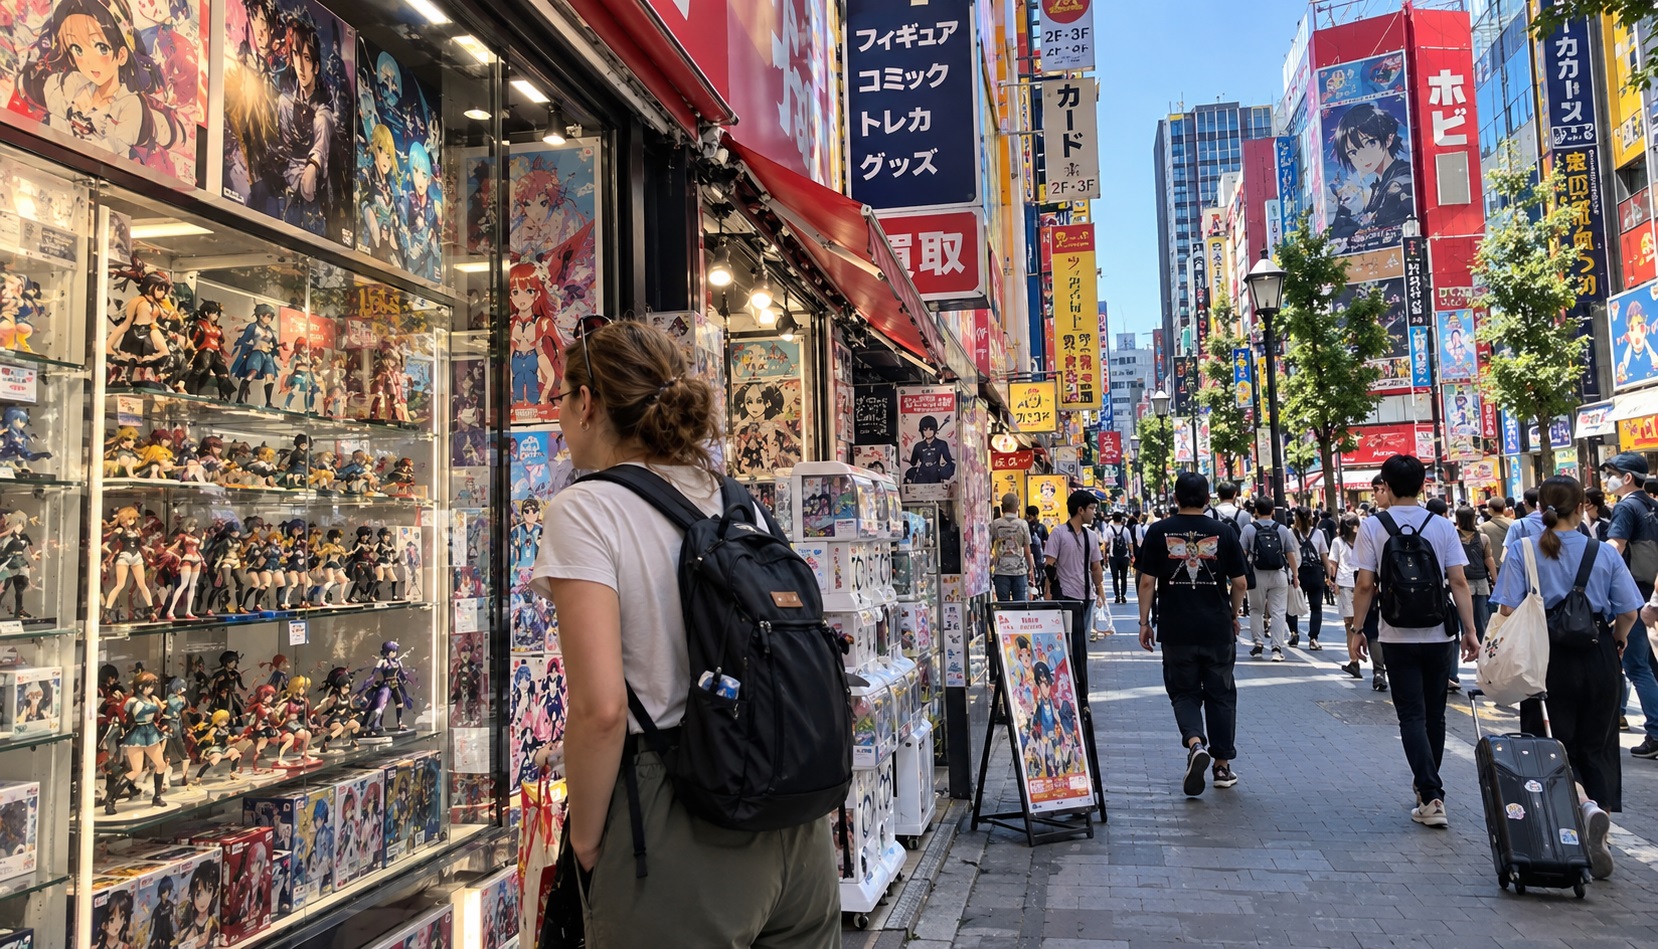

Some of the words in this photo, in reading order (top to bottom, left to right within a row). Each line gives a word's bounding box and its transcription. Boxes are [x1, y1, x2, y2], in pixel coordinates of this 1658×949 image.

[856, 20, 958, 52] フィギュア
[1045, 27, 1089, 43] 2F・3F
[859, 63, 949, 92] コミック
[861, 107, 931, 137] トレカ
[1057, 84, 1082, 158] カード
[1428, 69, 1468, 146] ホビ
[860, 147, 939, 181] グッズ
[1051, 179, 1094, 194] 2F・3F
